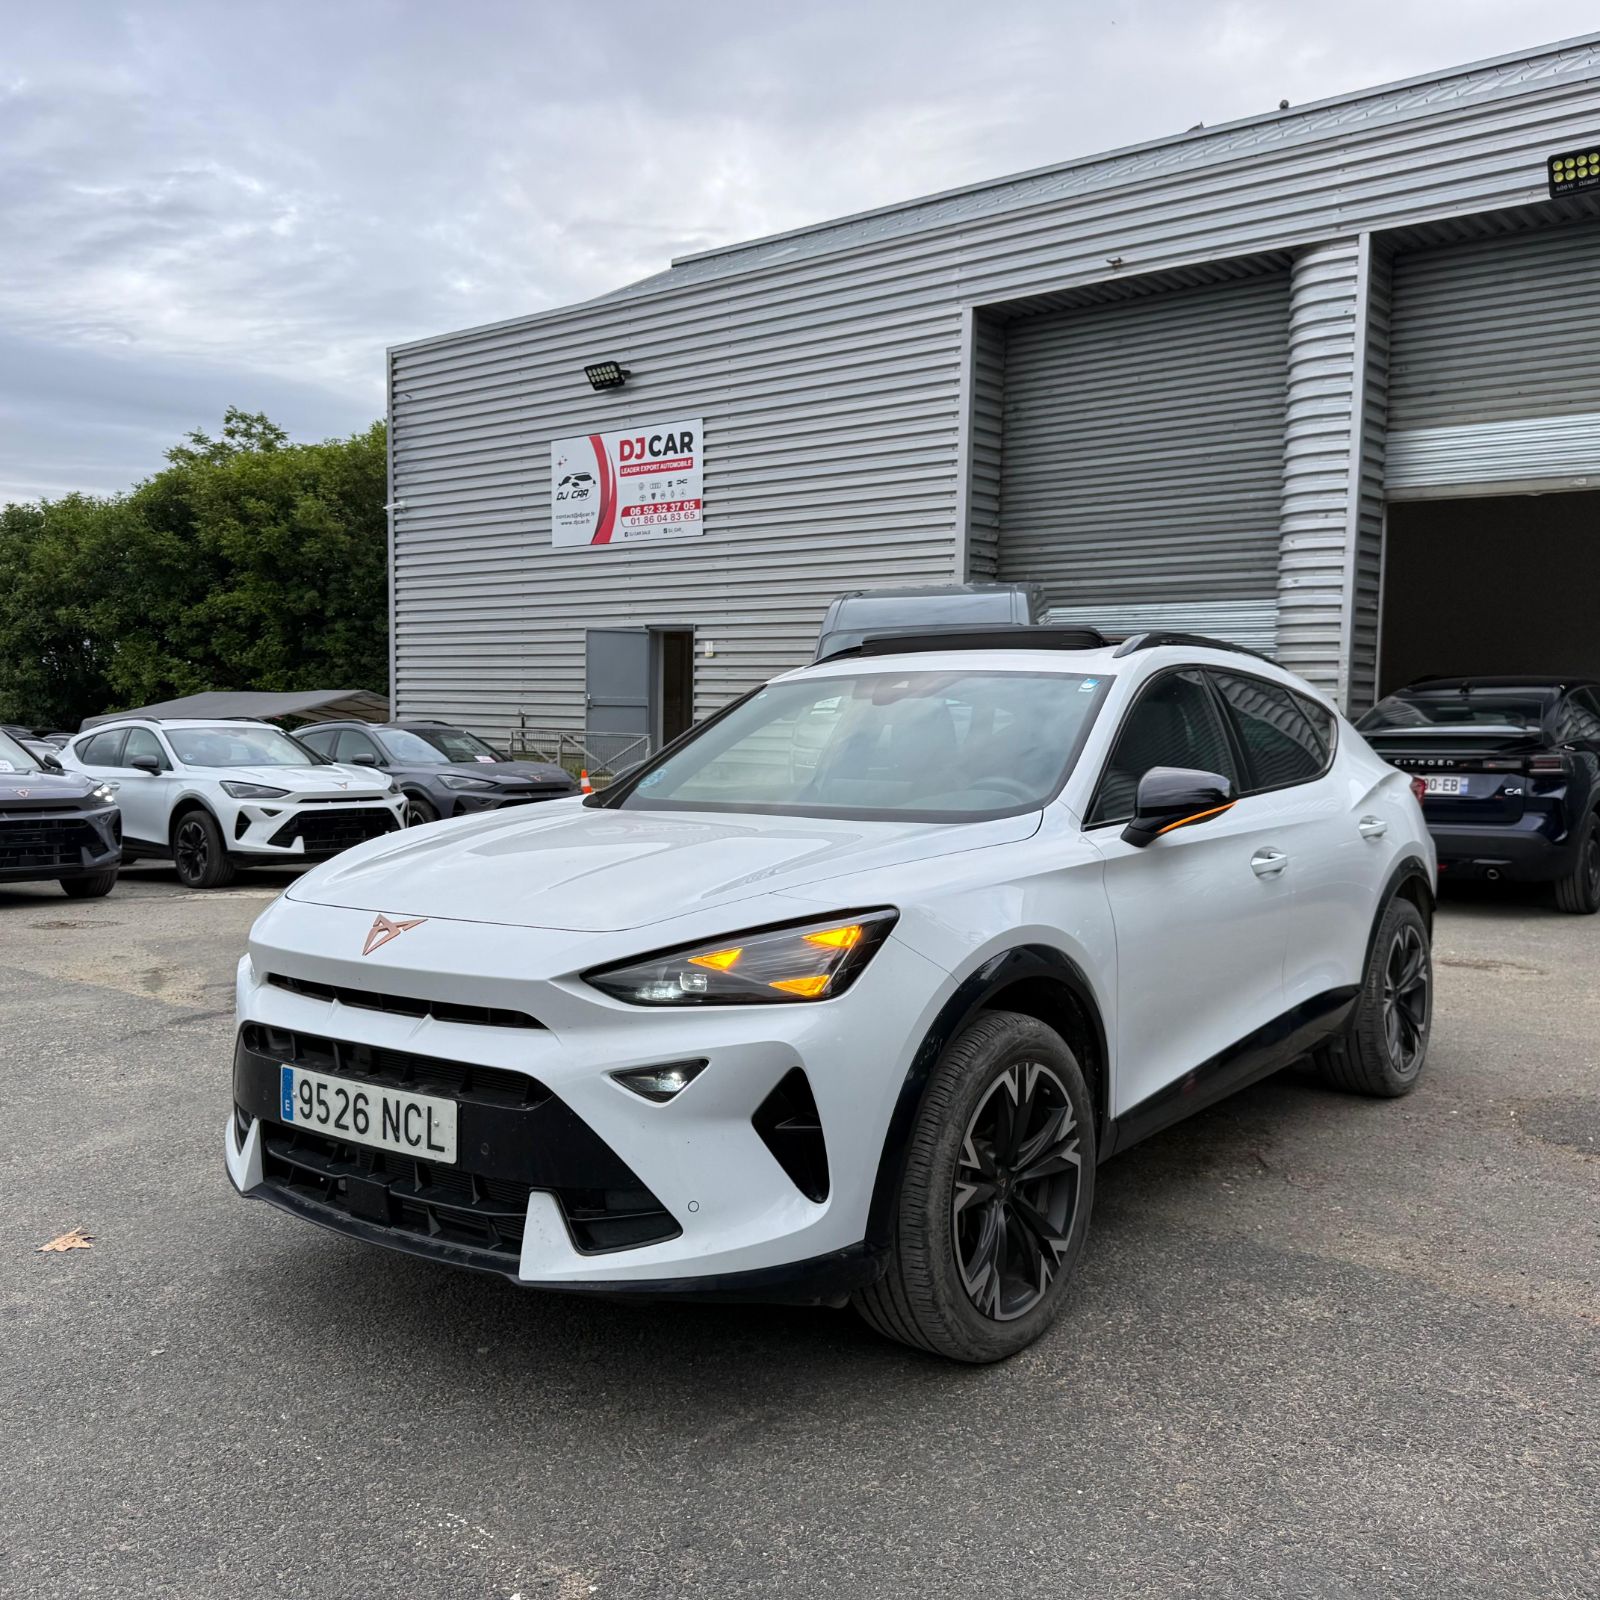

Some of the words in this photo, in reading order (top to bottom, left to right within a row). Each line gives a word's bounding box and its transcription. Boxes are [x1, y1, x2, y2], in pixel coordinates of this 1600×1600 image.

[621, 466, 640, 474] LEADER
[640, 464, 660, 472] EXPORT
[660, 460, 692, 469] AUTOMOBILE
[556, 492, 569, 500] DJ
[571, 489, 589, 499] CAR
[630, 507, 641, 515] 06
[643, 506, 654, 514] 52
[656, 504, 667, 513] 32
[670, 503, 681, 511] 37
[630, 517, 640, 525] 01
[657, 514, 667, 522] 04
[670, 513, 680, 521] 83
[684, 511, 695, 519] 65
[285, 1100, 290, 1111] E
[300, 1079, 370, 1134] 9526
[382, 1097, 445, 1152] NCL
